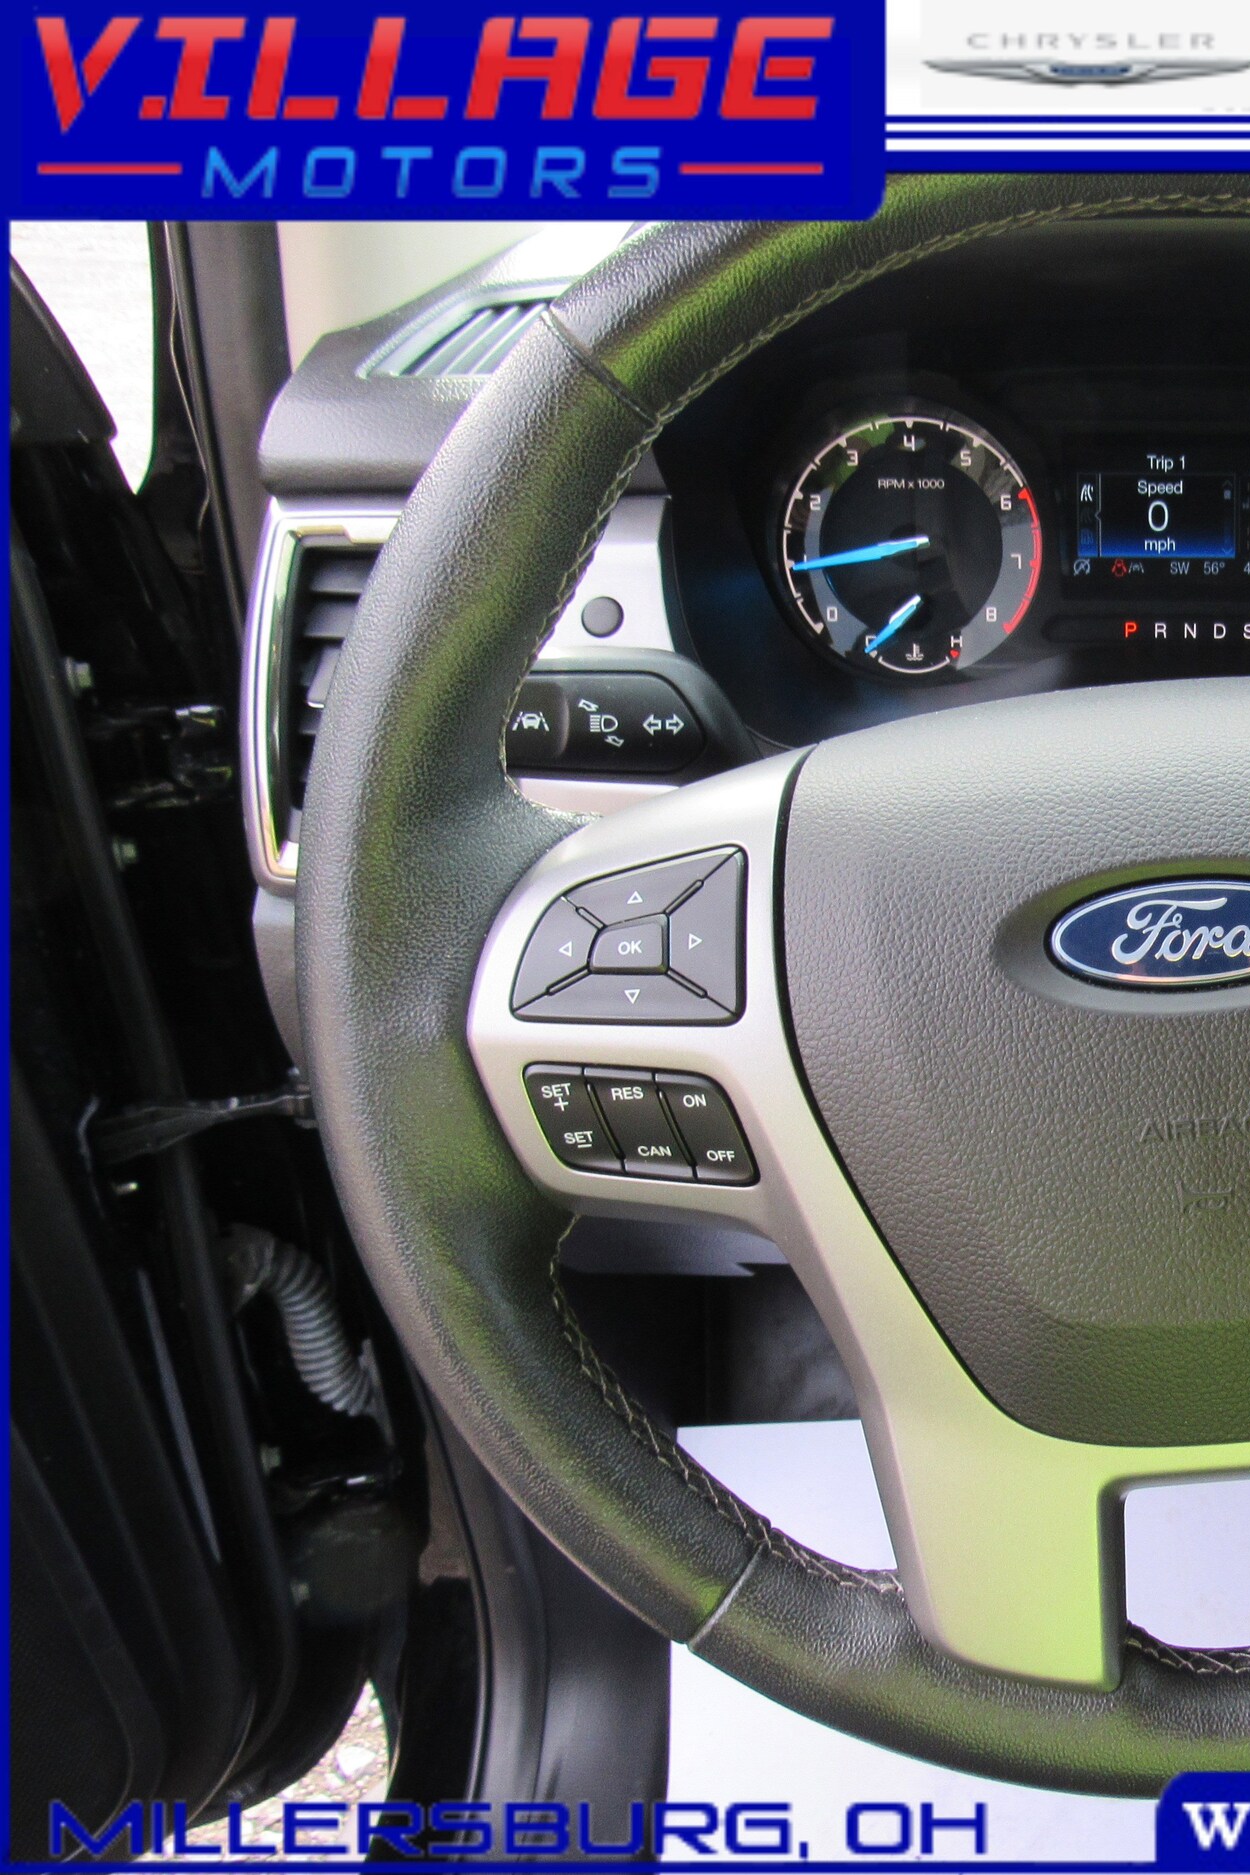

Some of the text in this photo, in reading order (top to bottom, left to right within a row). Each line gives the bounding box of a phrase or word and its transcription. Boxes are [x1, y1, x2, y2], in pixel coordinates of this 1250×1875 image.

[903, 435, 916, 450] 4
[847, 451, 858, 466] 3
[960, 451, 971, 466] 5
[1147, 455, 1186, 472] Trip 1
[878, 479, 905, 489] RPM
[918, 480, 944, 488] 1000
[1137, 480, 1183, 497] Speed
[810, 495, 821, 510] 2
[1000, 495, 1011, 510] 6
[1148, 501, 1169, 532] 0
[1144, 538, 1176, 553] mph
[1010, 554, 1021, 569] 7
[1170, 562, 1190, 574] SW
[827, 607, 837, 622] 0
[986, 607, 997, 622] 8
[1125, 622, 1138, 638] P
[1154, 623, 1167, 638] R
[1184, 623, 1197, 639] N
[1214, 624, 1226, 639] D
[951, 636, 962, 647] H
[618, 941, 642, 955] OK
[541, 1083, 571, 1099] SET
[611, 1087, 644, 1100] RES
[683, 1095, 706, 1107] ON
[564, 1131, 593, 1144] SET
[638, 1146, 671, 1157] CAN
[707, 1150, 735, 1162] OFF
